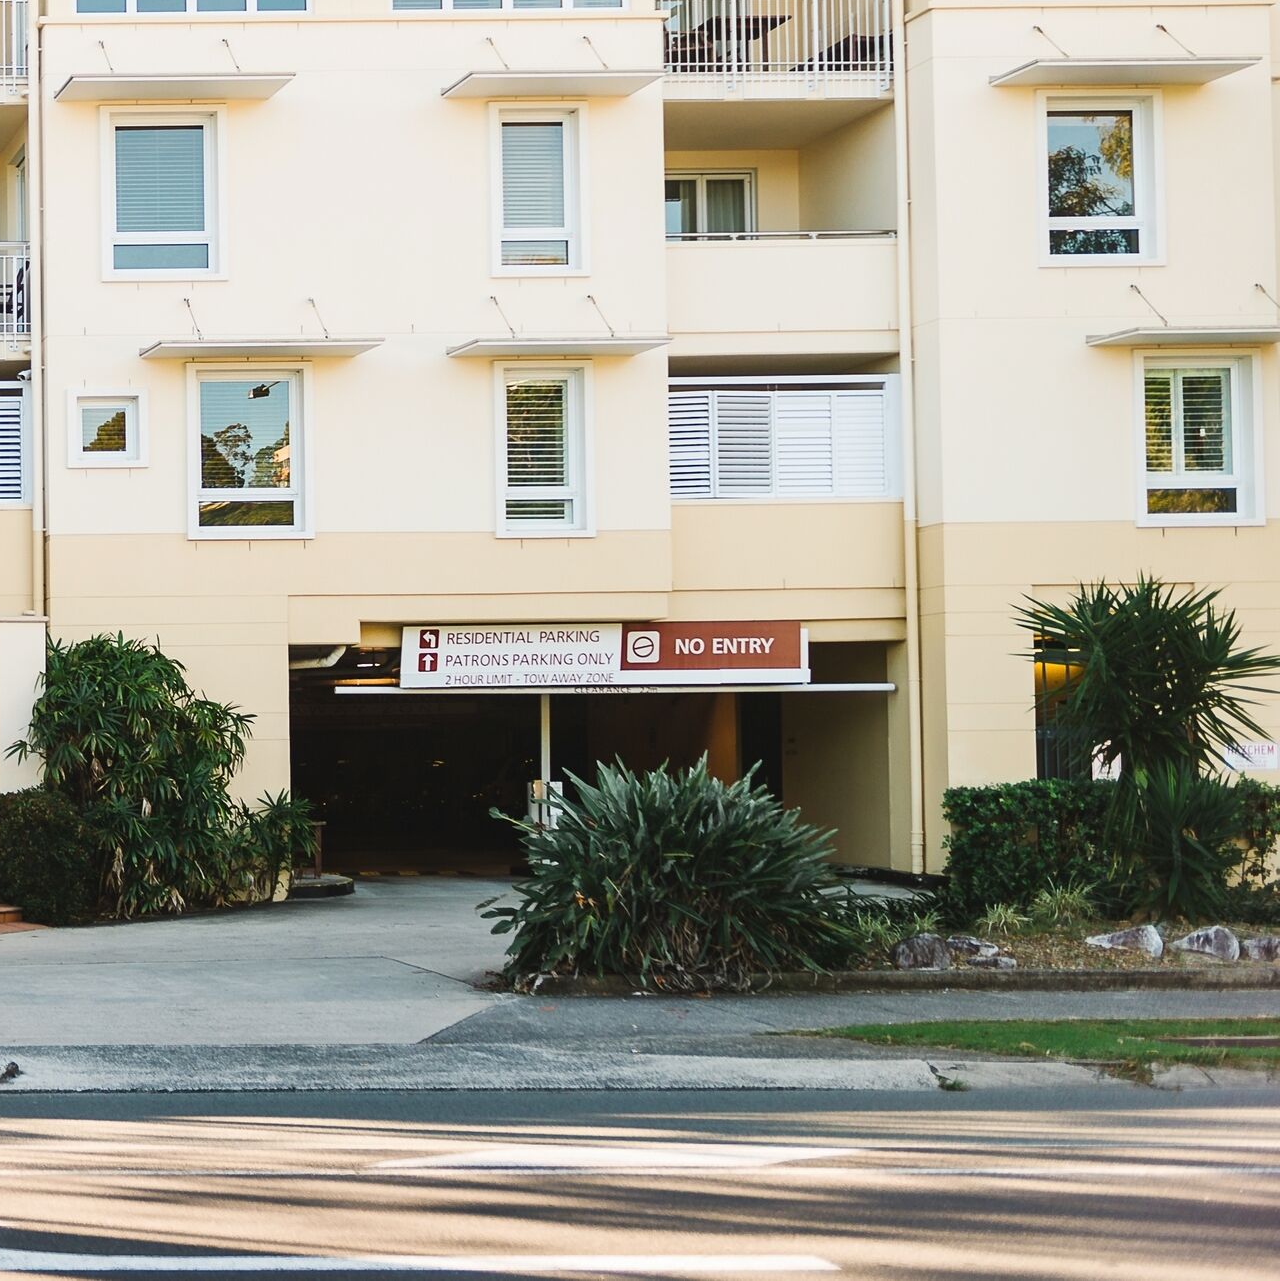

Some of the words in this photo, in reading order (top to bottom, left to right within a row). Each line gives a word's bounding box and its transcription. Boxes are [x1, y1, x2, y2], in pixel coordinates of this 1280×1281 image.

[446, 631, 534, 645] RESIDENTIAL
[539, 630, 600, 643] PARKING
[675, 638, 705, 655] NO
[712, 637, 775, 655] ENTRY
[445, 654, 509, 667] PATRONS
[512, 653, 574, 666] PARKING
[577, 652, 614, 665] ONLY
[445, 674, 452, 685] 2
[454, 674, 484, 685] HOUR
[486, 673, 513, 684] LIMIT
[523, 673, 549, 684] TOW
[550, 673, 584, 683] AWAY
[586, 672, 614, 683] ZONE
